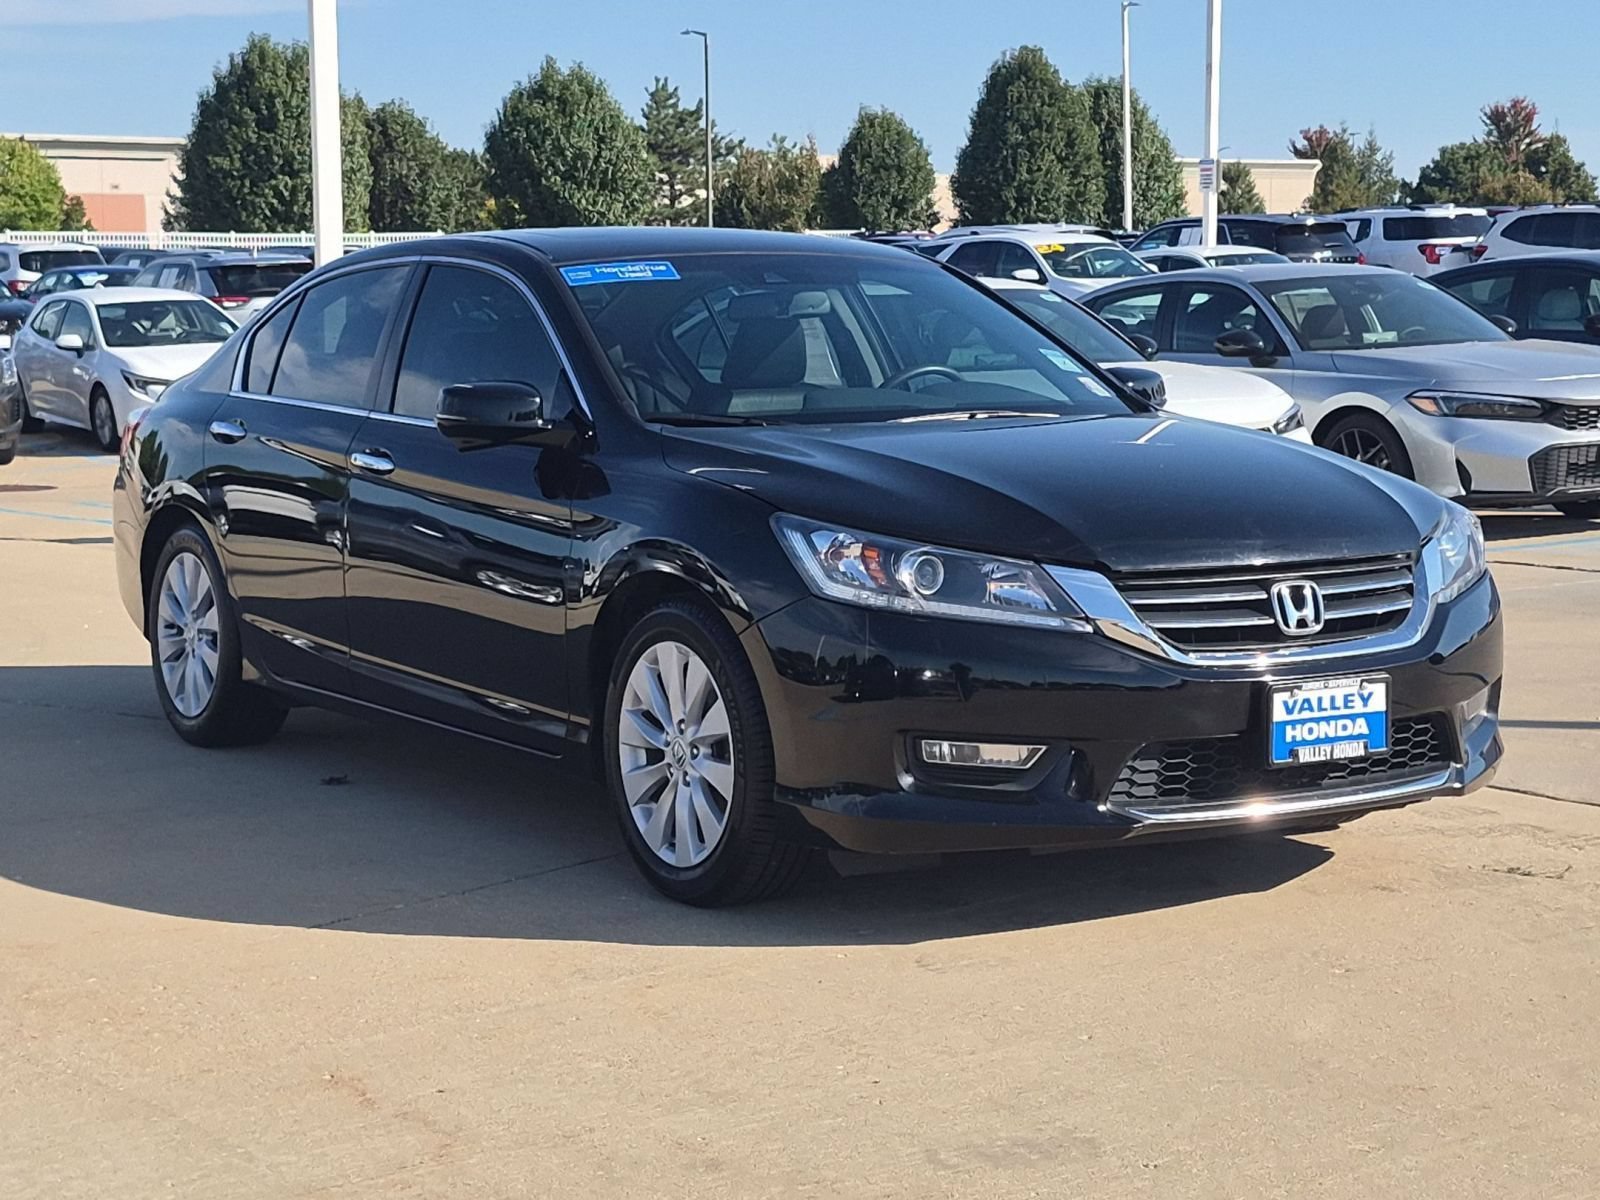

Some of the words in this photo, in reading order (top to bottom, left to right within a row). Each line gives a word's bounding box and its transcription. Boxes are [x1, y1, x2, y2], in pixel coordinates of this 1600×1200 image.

[1282, 691, 1374, 716] VALLEY
[1285, 717, 1370, 743] HONDA
[1298, 746, 1332, 763] VALLEY
[1333, 742, 1365, 760] HONDA
